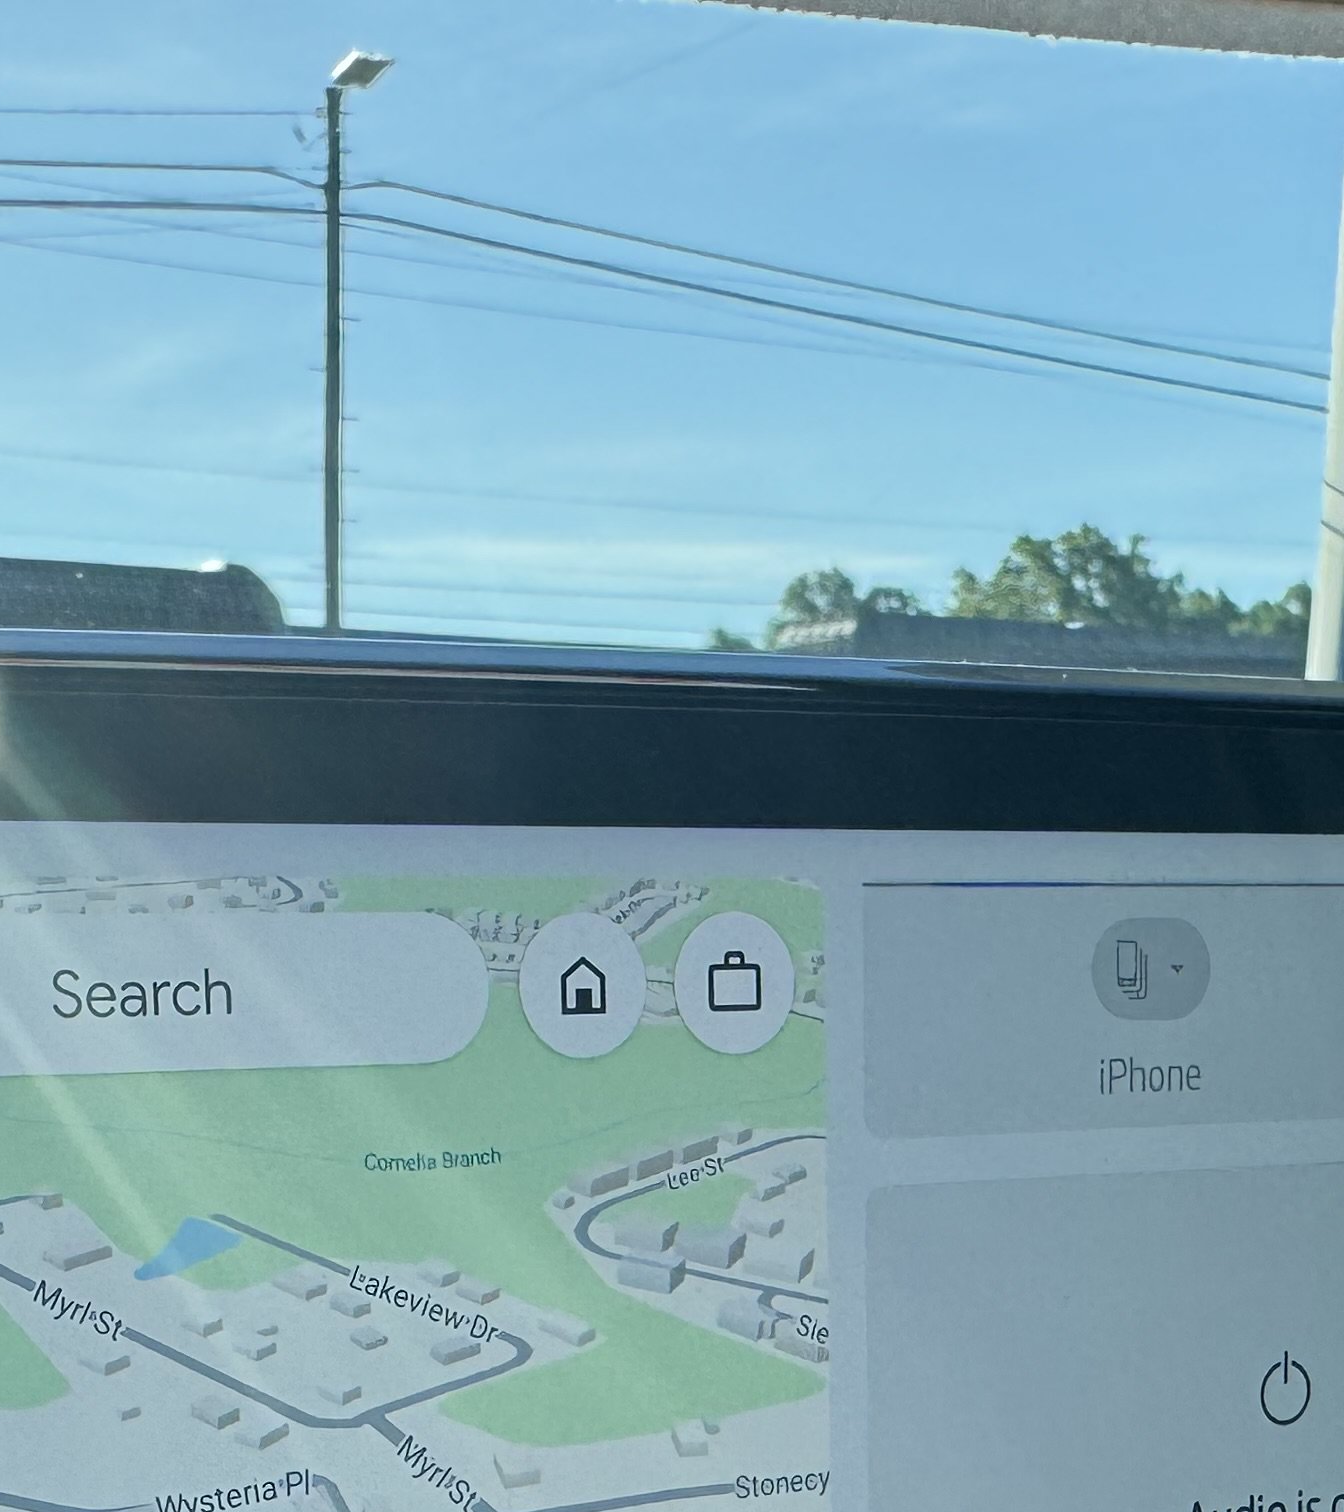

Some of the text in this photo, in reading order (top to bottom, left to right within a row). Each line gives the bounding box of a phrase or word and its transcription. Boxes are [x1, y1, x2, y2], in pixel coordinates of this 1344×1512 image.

[52, 967, 233, 1019] Search
[1099, 1056, 1202, 1095] iPhone
[442, 1146, 502, 1169] Branch
[703, 1157, 725, 1177] St
[32, 1279, 123, 1342] Myrl St
[349, 1264, 499, 1343] Lakeview Dr
[396, 1434, 452, 1488] Myrl
[285, 1468, 310, 1497] Pl
[735, 1470, 830, 1499] Stonecy
